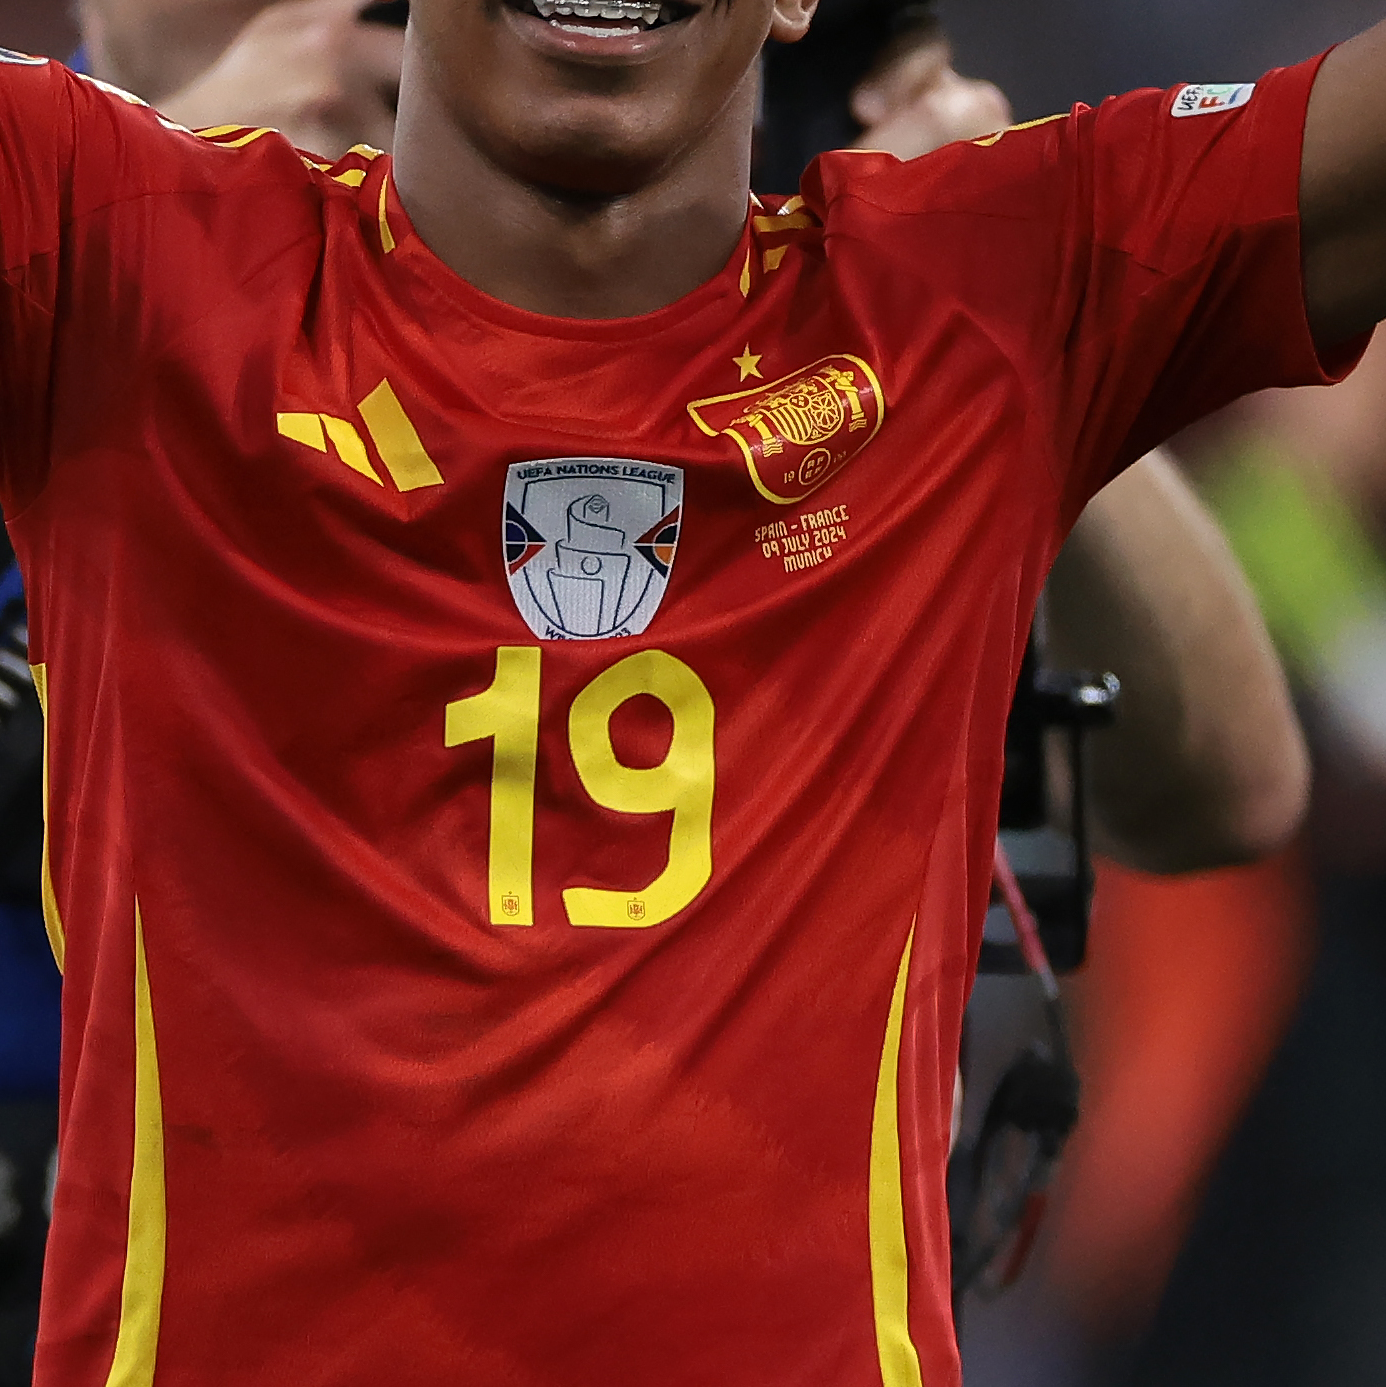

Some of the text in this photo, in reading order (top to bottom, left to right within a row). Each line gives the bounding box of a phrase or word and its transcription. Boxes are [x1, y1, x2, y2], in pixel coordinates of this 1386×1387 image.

[517, 464, 676, 484] UEFA NATIONS LEAGUE
[754, 520, 788, 543] SPAIN
[800, 504, 849, 531] FRANCE
[762, 525, 847, 559] 09 JULY 2024
[783, 546, 833, 574] MUNICH
[444, 645, 716, 928] 19
